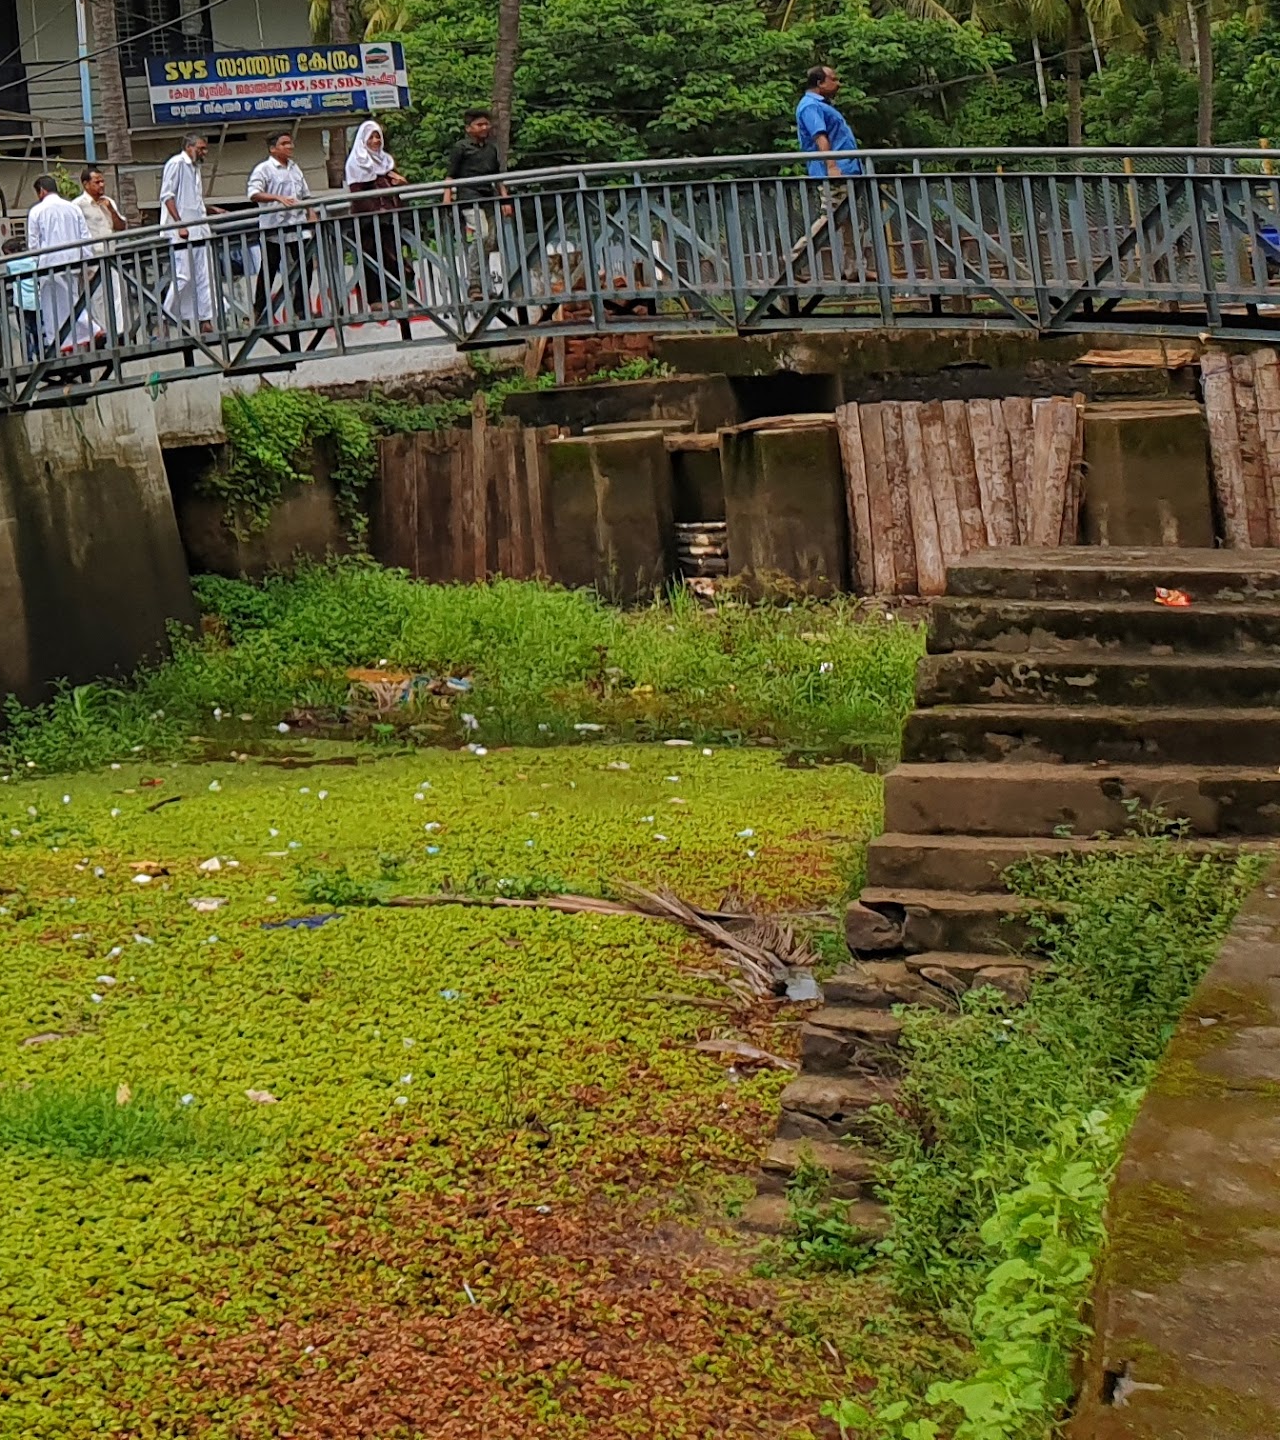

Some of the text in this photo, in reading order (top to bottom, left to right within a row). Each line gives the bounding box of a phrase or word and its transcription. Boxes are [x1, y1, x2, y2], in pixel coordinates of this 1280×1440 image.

[165, 49, 359, 82] SYS സാന്ത്വന കേന്ദ്രം
